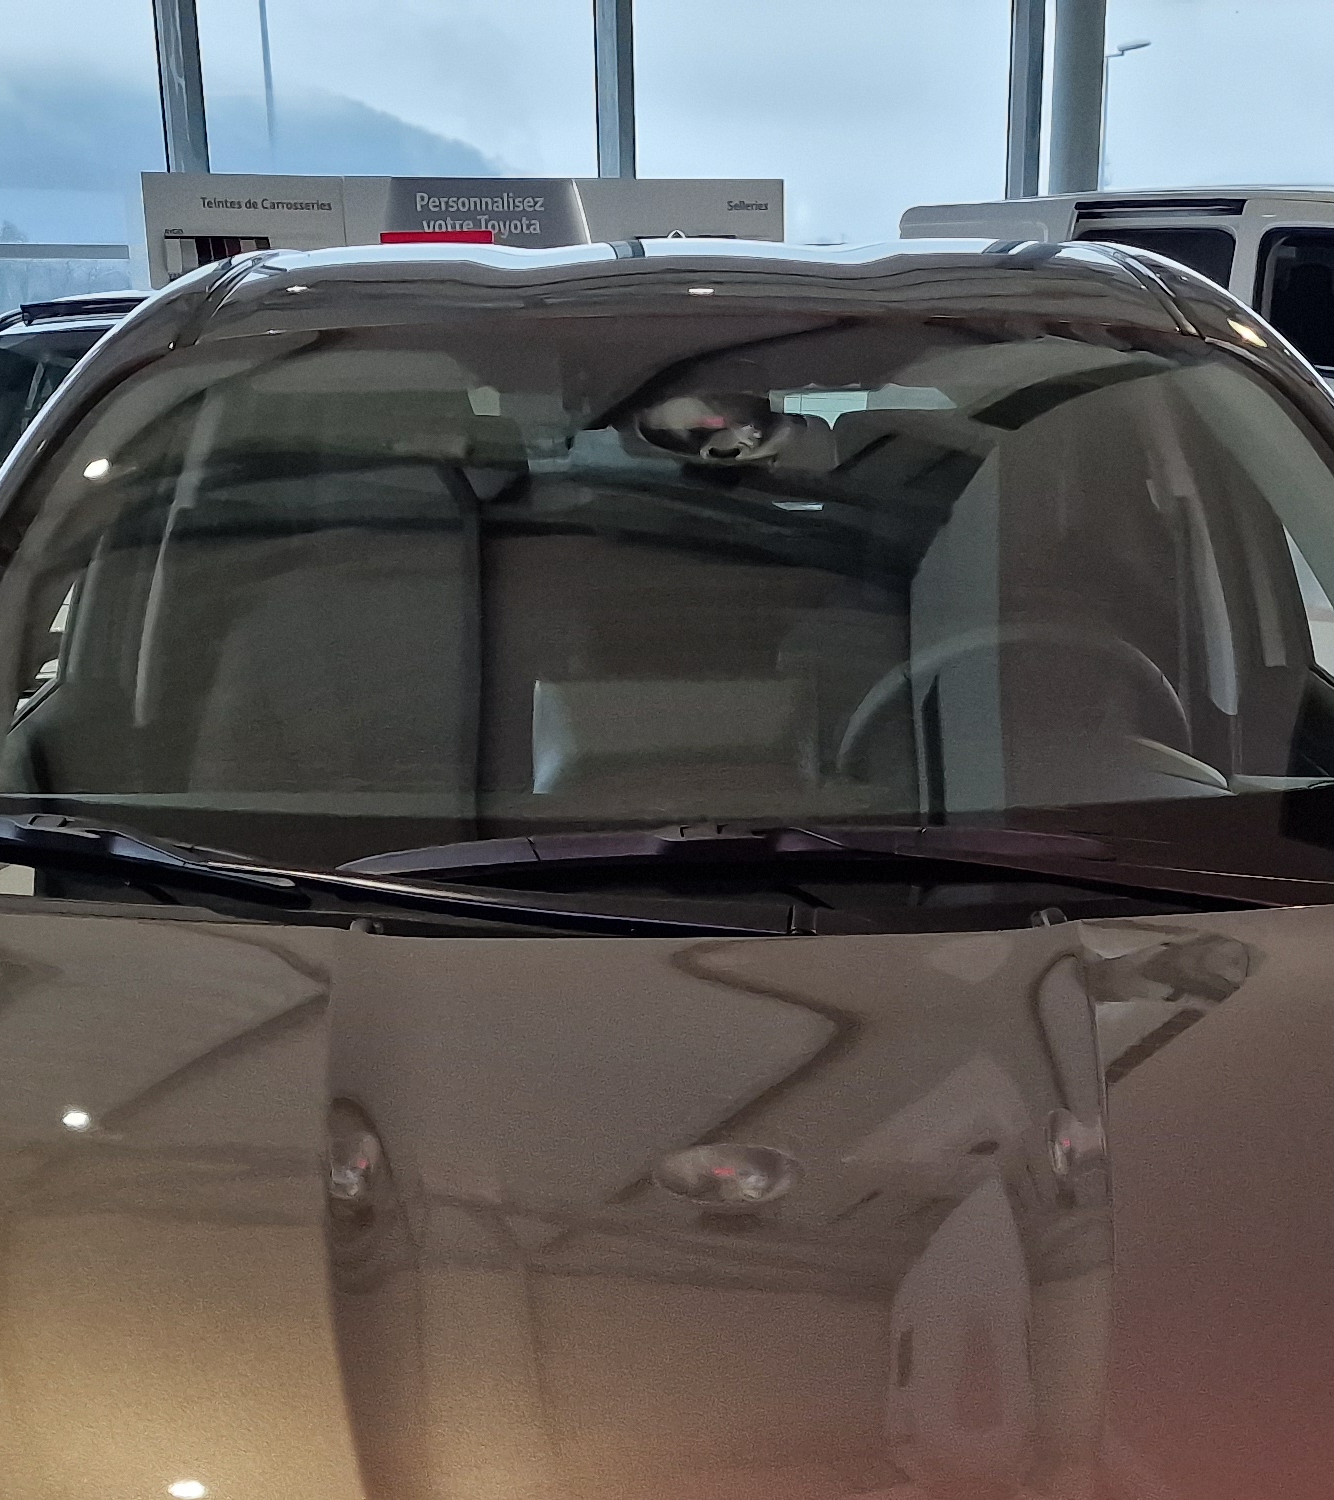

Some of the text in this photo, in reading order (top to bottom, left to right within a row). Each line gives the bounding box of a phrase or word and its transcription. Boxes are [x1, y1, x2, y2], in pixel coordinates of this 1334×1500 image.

[200, 197, 333, 211] Teintes de Carrosseries
[416, 193, 545, 213] Personnalisez
[726, 199, 769, 211] Selleries
[477, 215, 541, 239] Toyota
